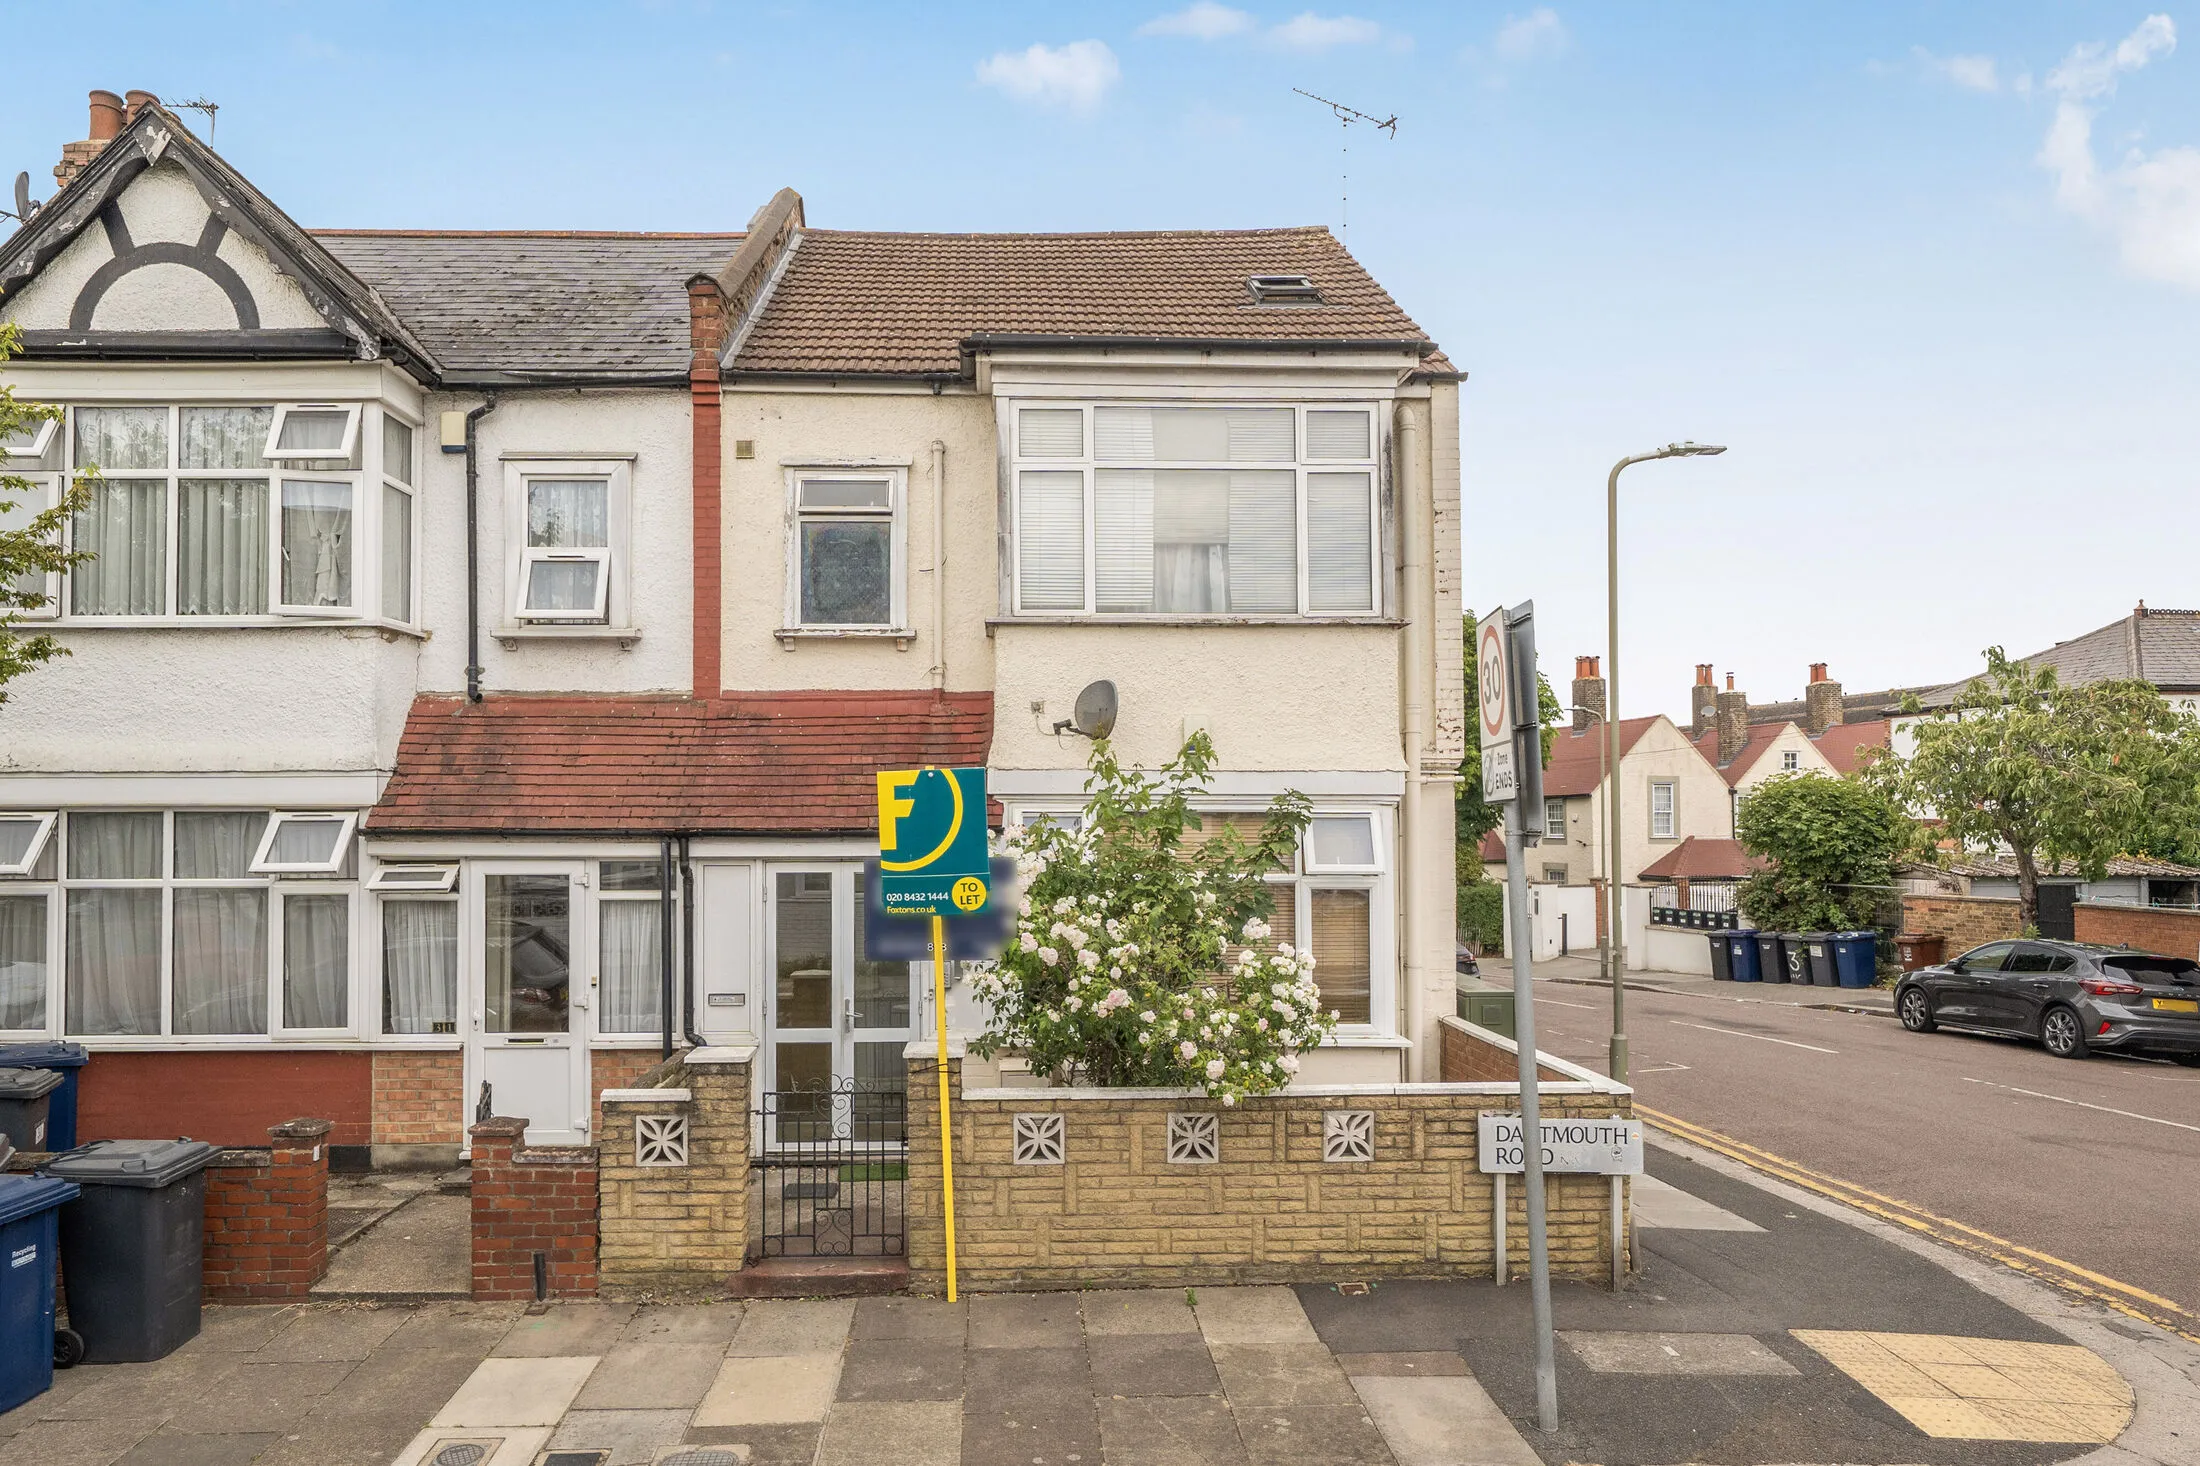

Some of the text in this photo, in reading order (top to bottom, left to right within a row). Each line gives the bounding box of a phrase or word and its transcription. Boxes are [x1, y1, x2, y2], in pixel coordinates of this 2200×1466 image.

[1483, 655, 1501, 705] 30
[1497, 752, 1508, 766] Zone
[1496, 770, 1512, 789] ENDS
[877, 769, 920, 850] F
[886, 891, 949, 901] 020 8432 1444
[960, 882, 978, 892] TO
[960, 894, 980, 905] LET
[1787, 951, 1800, 971] 3
[436, 1023, 452, 1032] 31
[1495, 1125, 1628, 1145] DATMOUTH
[1496, 1147, 1554, 1165] ROD
